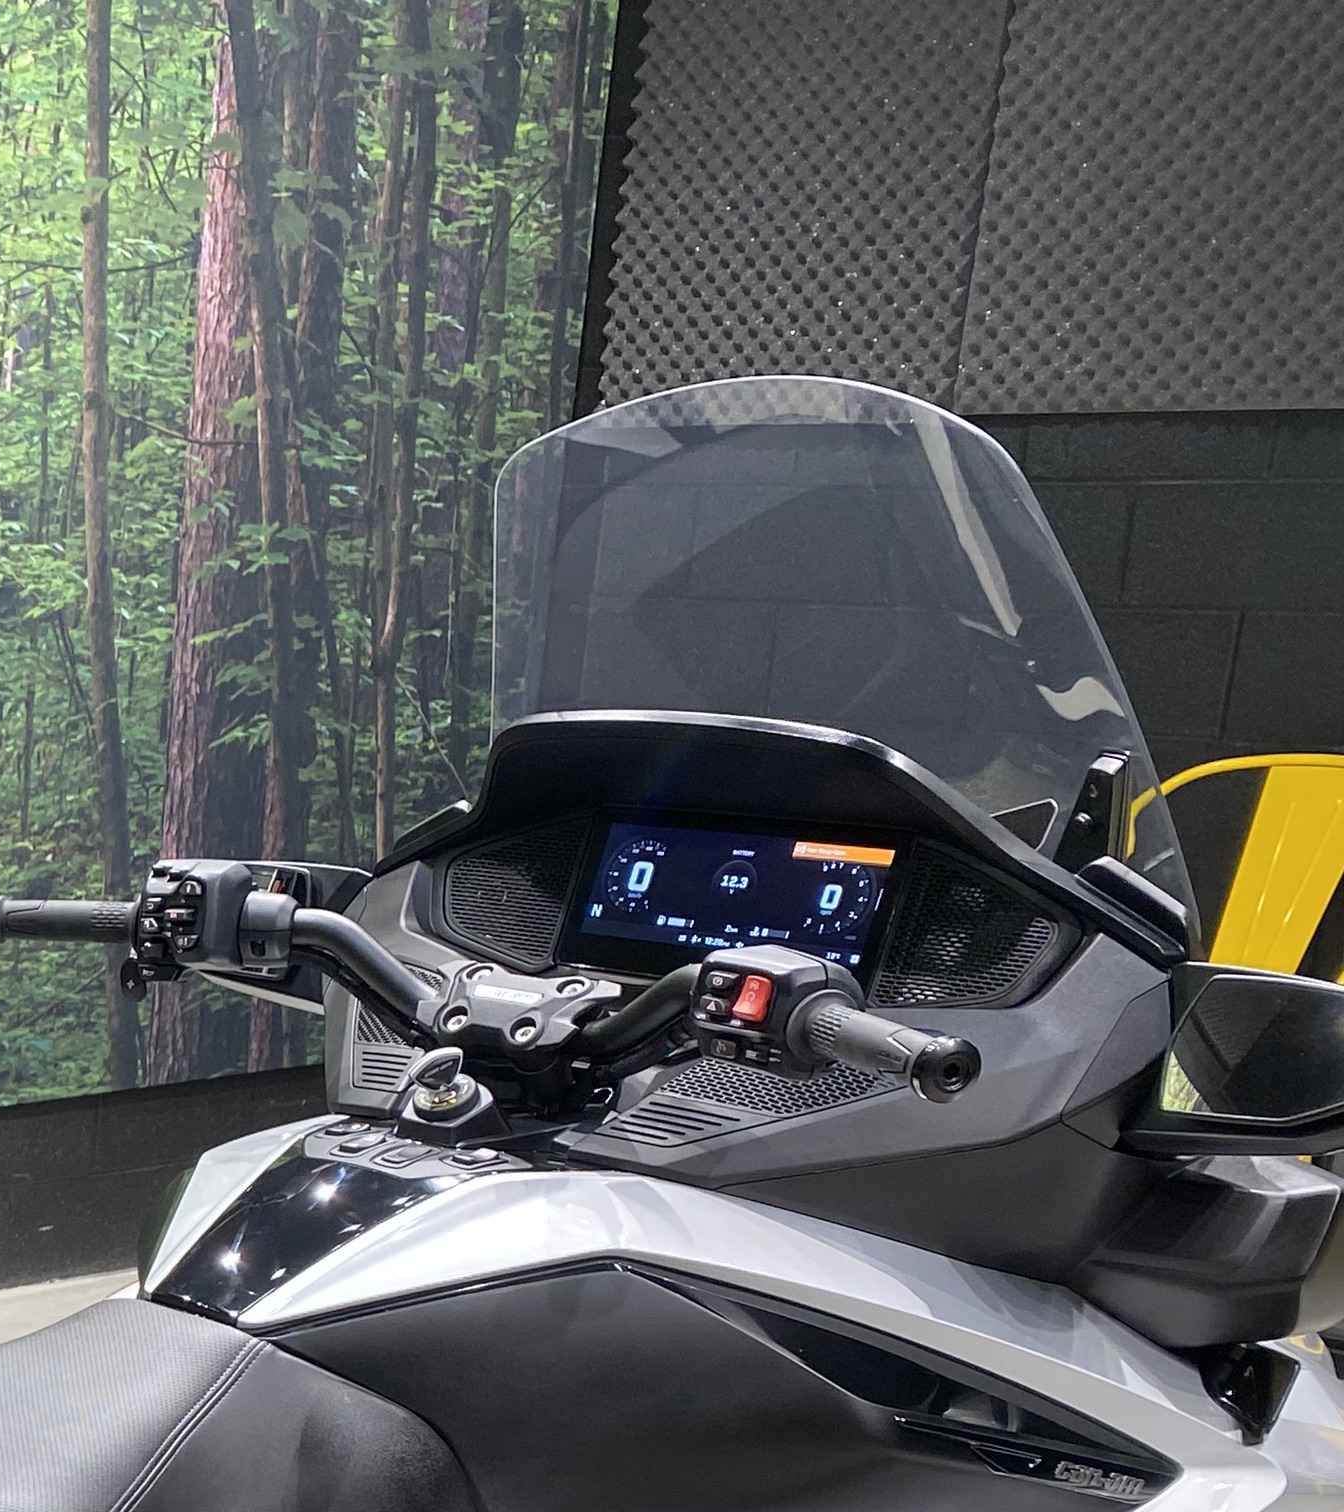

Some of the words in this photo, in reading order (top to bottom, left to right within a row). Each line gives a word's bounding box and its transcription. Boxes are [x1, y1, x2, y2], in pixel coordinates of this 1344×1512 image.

[627, 861, 654, 892] 0
[720, 874, 749, 889] 12.3
[819, 884, 843, 909] 0
[590, 903, 603, 917] N
